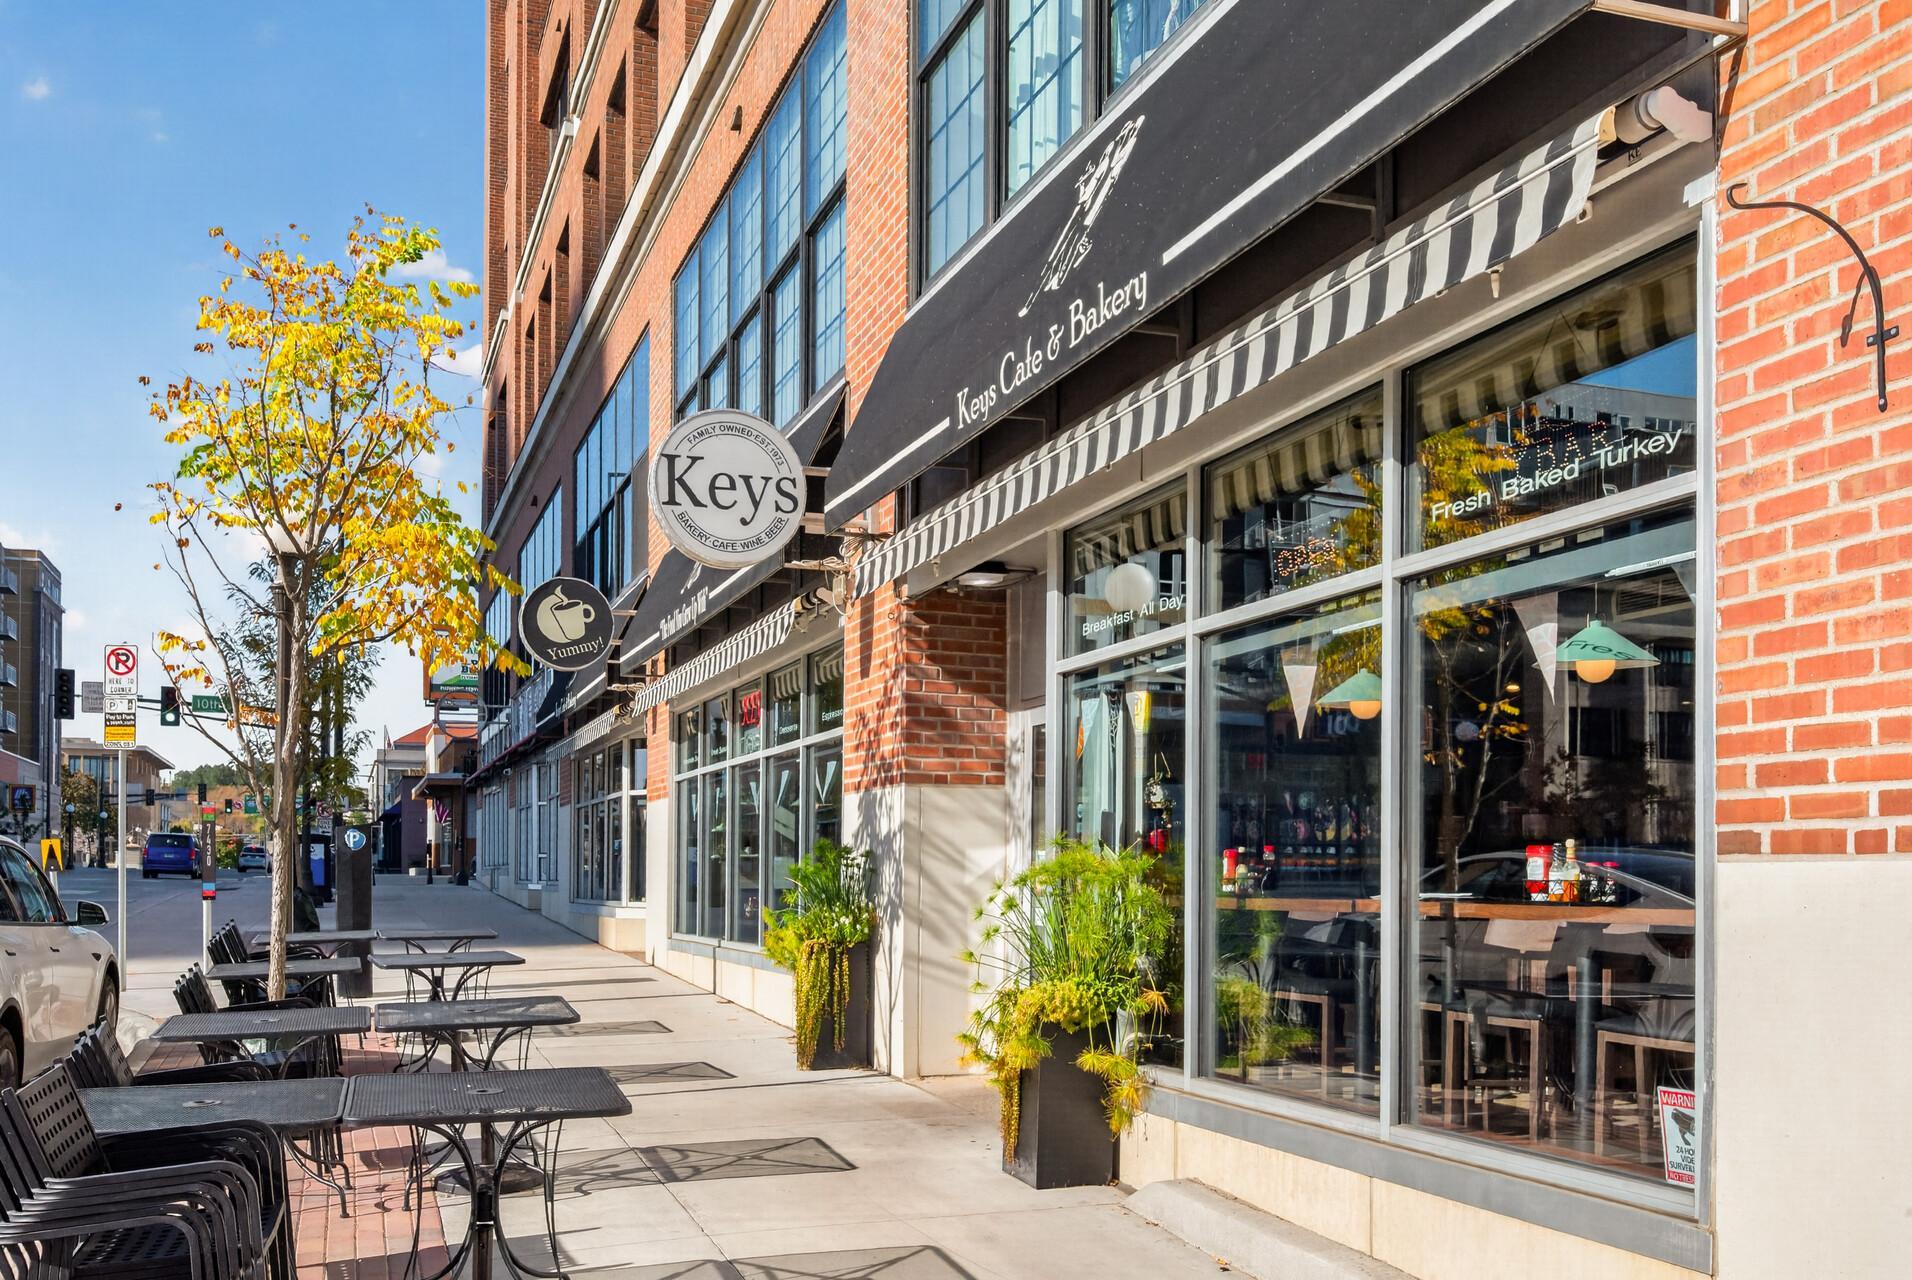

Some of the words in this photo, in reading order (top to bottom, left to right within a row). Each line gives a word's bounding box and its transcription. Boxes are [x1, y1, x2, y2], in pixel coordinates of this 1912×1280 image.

[957, 387, 997, 429] Keys
[1000, 336, 1043, 394] Cafe
[1047, 324, 1065, 361] &
[1069, 271, 1147, 348] Bakery
[687, 426, 717, 444] FAMILY
[661, 453, 799, 526] Keys
[1431, 490, 1491, 523] Fresh
[1501, 457, 1580, 500] Baked
[1590, 429, 1683, 470] Turkey
[677, 511, 711, 543] BAKERY
[766, 517, 786, 539] BEER
[1082, 609, 1134, 637] Breakfast
[1140, 601, 1154, 618] All
[1160, 595, 1184, 613] Day
[547, 636, 604, 660] Yummy!
